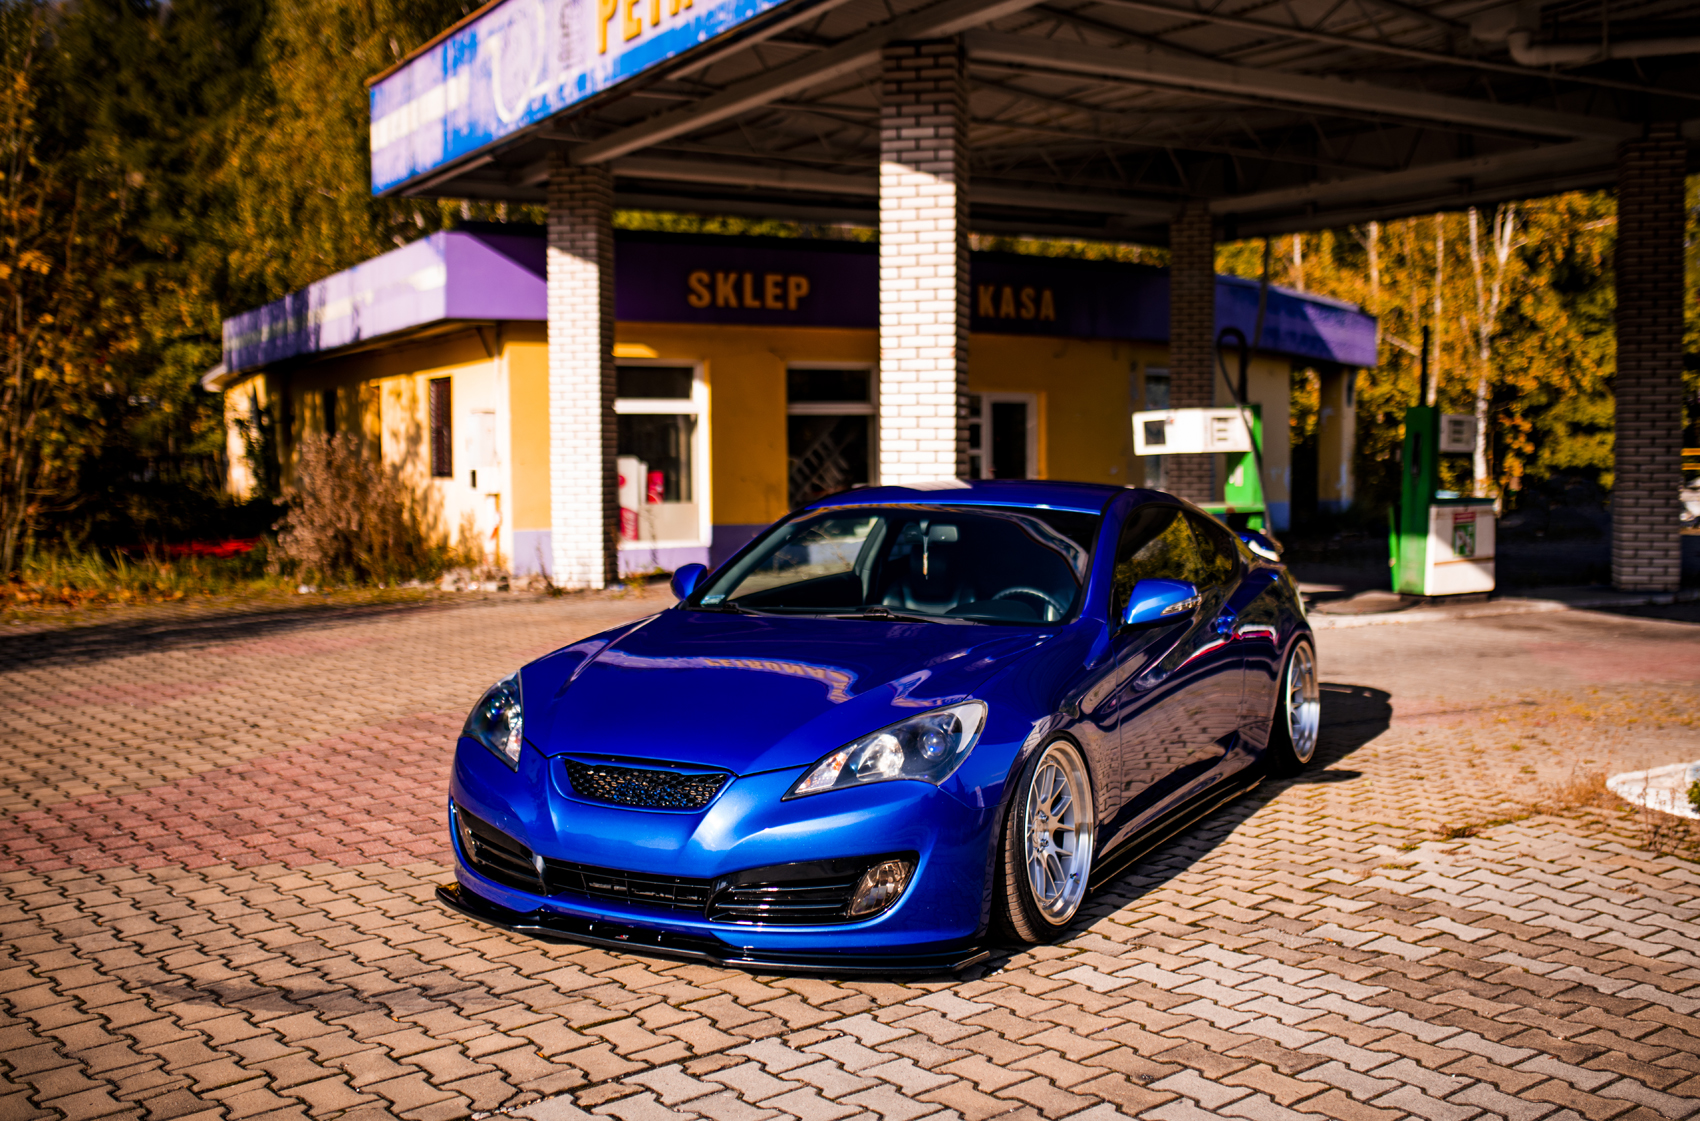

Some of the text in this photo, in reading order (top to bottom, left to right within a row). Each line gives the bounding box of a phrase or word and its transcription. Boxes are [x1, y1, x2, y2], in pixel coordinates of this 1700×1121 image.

[598, 0, 693, 55] PE
[687, 270, 810, 311] SKLEP
[978, 285, 1056, 321] KASA
